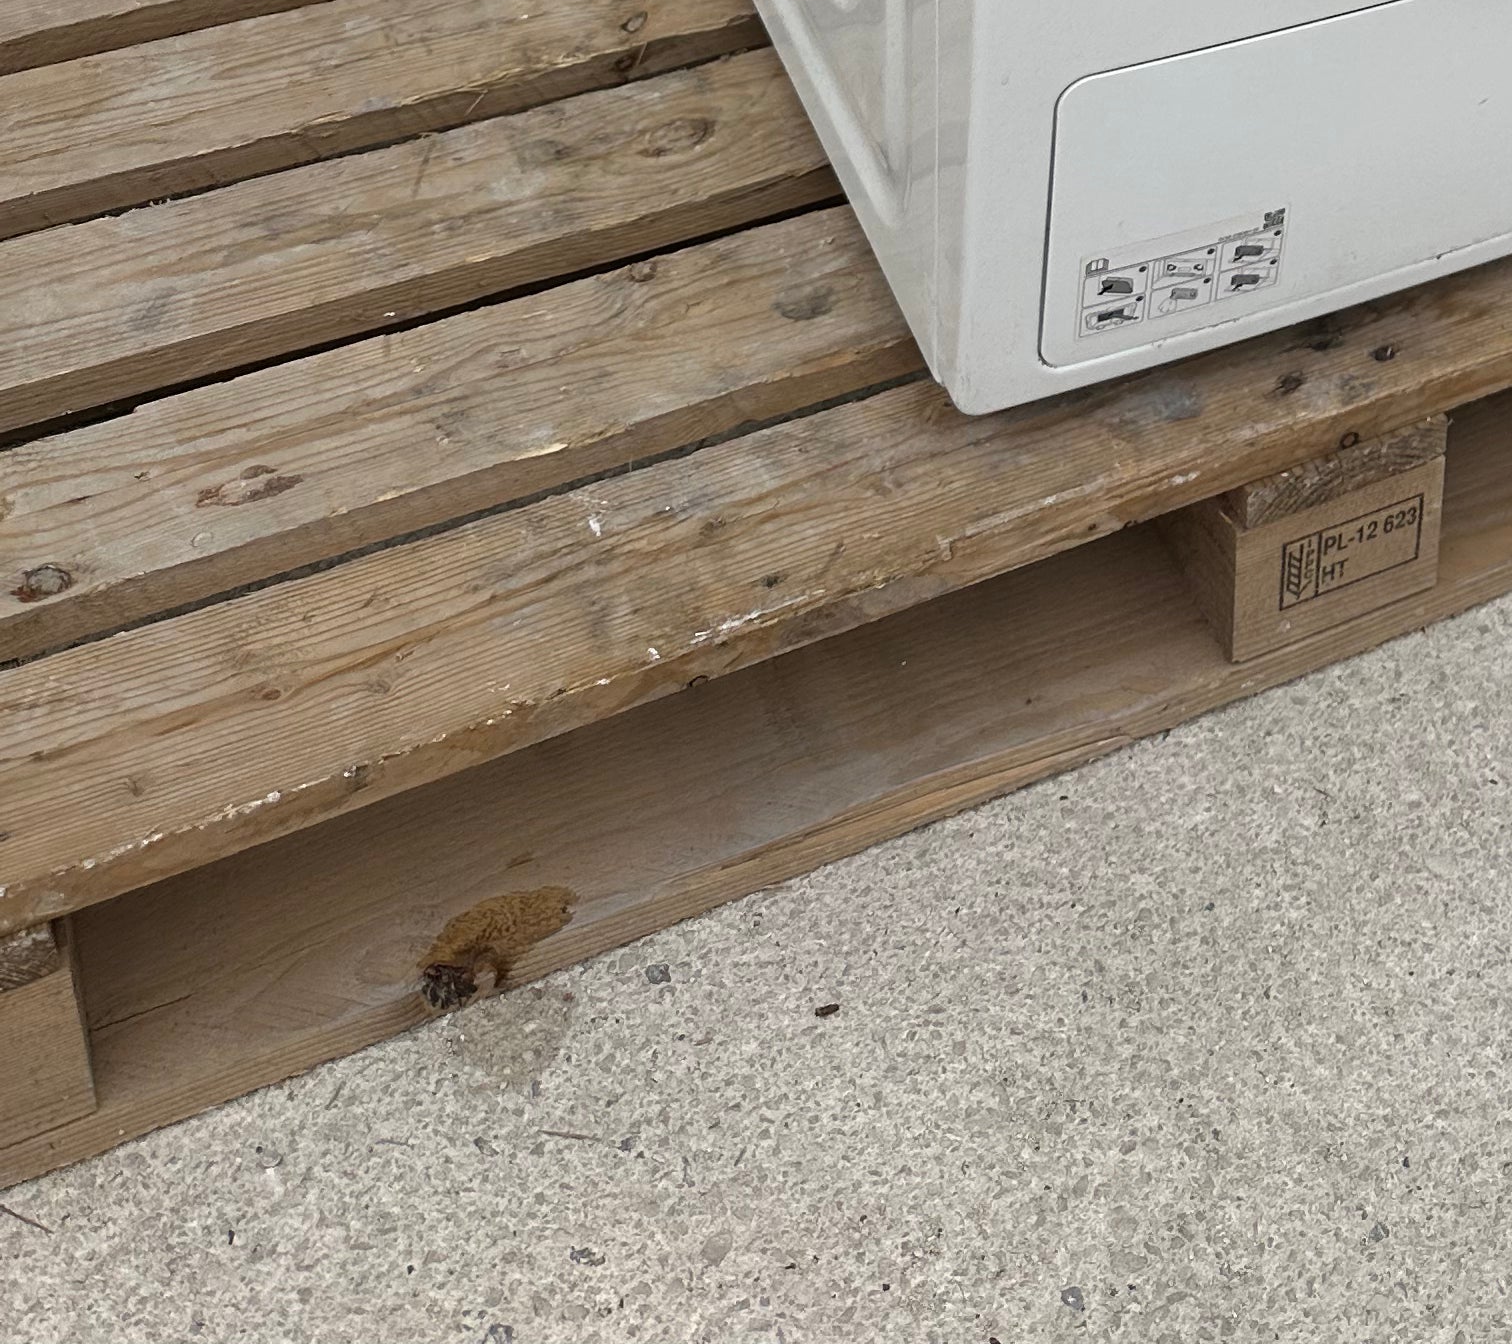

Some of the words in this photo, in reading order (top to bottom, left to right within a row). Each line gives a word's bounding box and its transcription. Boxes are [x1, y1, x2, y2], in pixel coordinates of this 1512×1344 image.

[1323, 520, 1378, 556] PL-12
[1383, 506, 1418, 534] 623
[1321, 557, 1349, 585] HT
